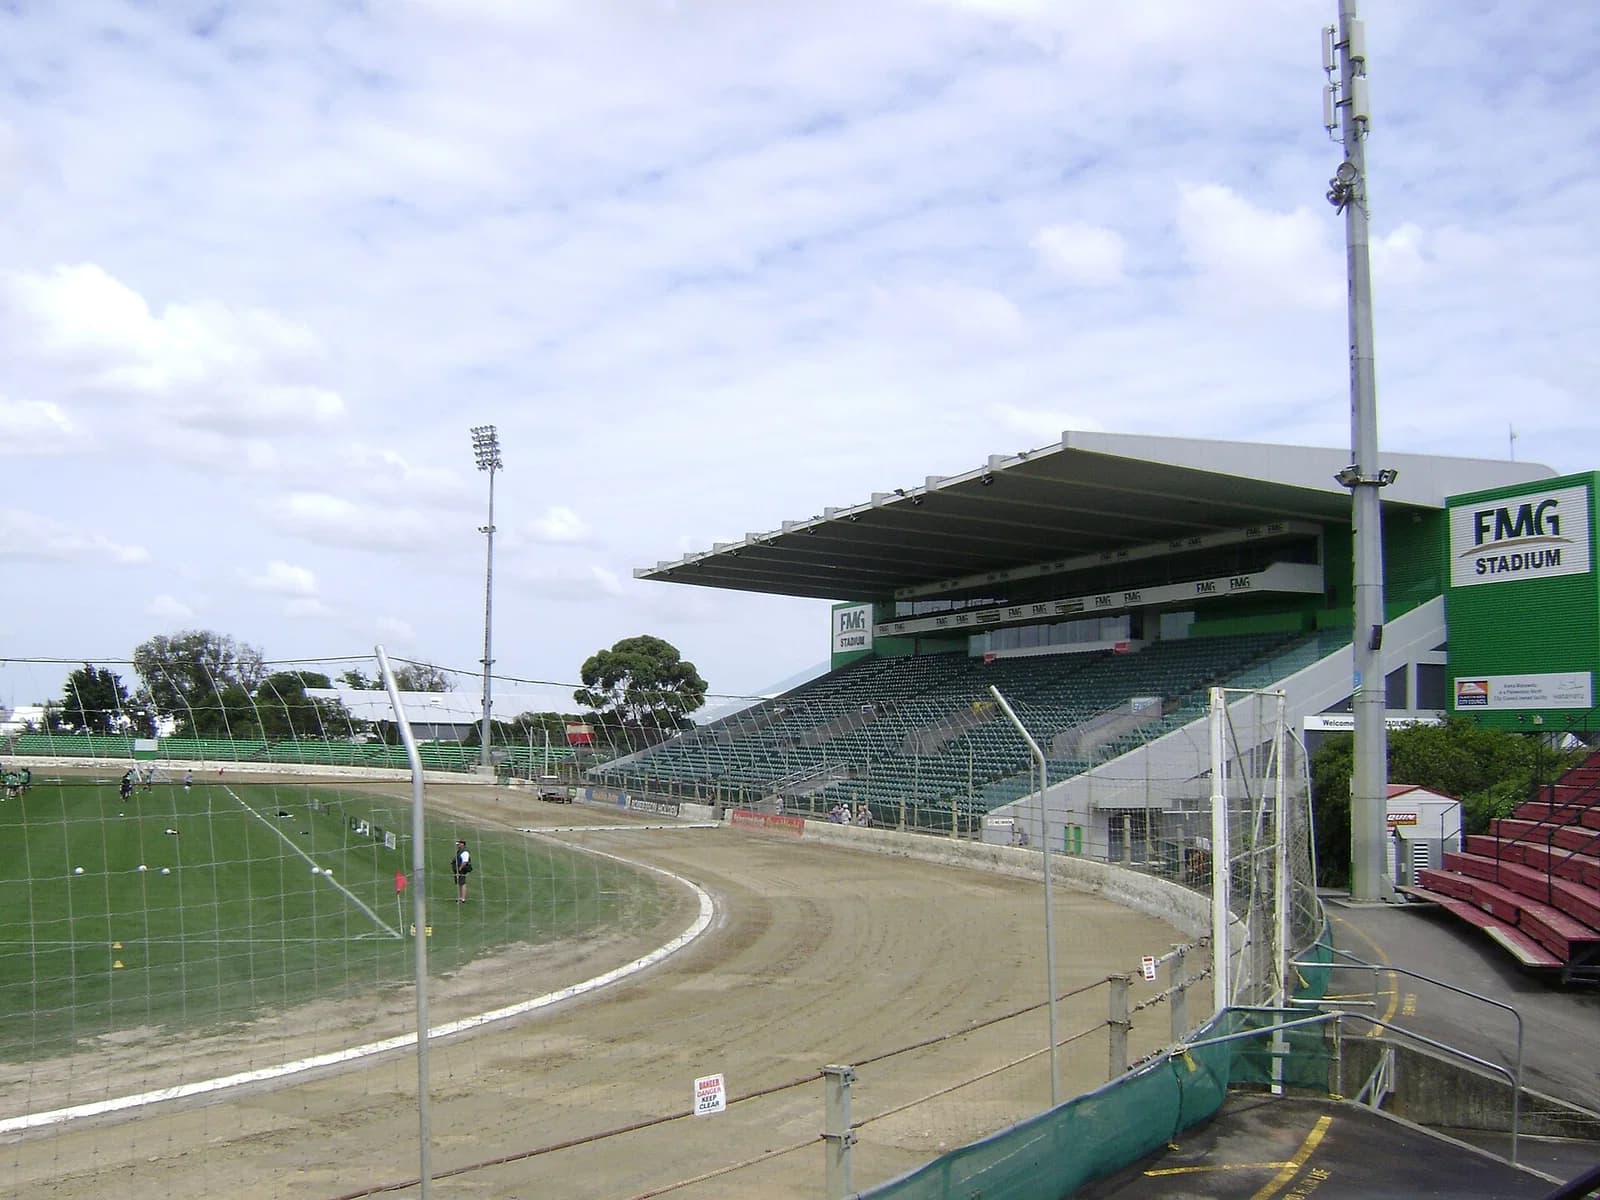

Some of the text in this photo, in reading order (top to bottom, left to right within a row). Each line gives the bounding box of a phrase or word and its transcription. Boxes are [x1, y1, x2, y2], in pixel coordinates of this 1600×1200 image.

[1474, 499, 1560, 545] FMG
[1475, 548, 1561, 575] STADIUM
[1008, 607, 1021, 617] FMG
[1032, 604, 1047, 614] FMG
[1095, 595, 1111, 606] FMG
[1124, 591, 1141, 602] FMG
[1196, 581, 1215, 593] FMG
[1230, 576, 1250, 589] FMG
[840, 609, 865, 631] FMG
[840, 635, 865, 647] STADIUM
[699, 1078, 720, 1089] DANGER
[699, 1101, 719, 1109] CLEAR
